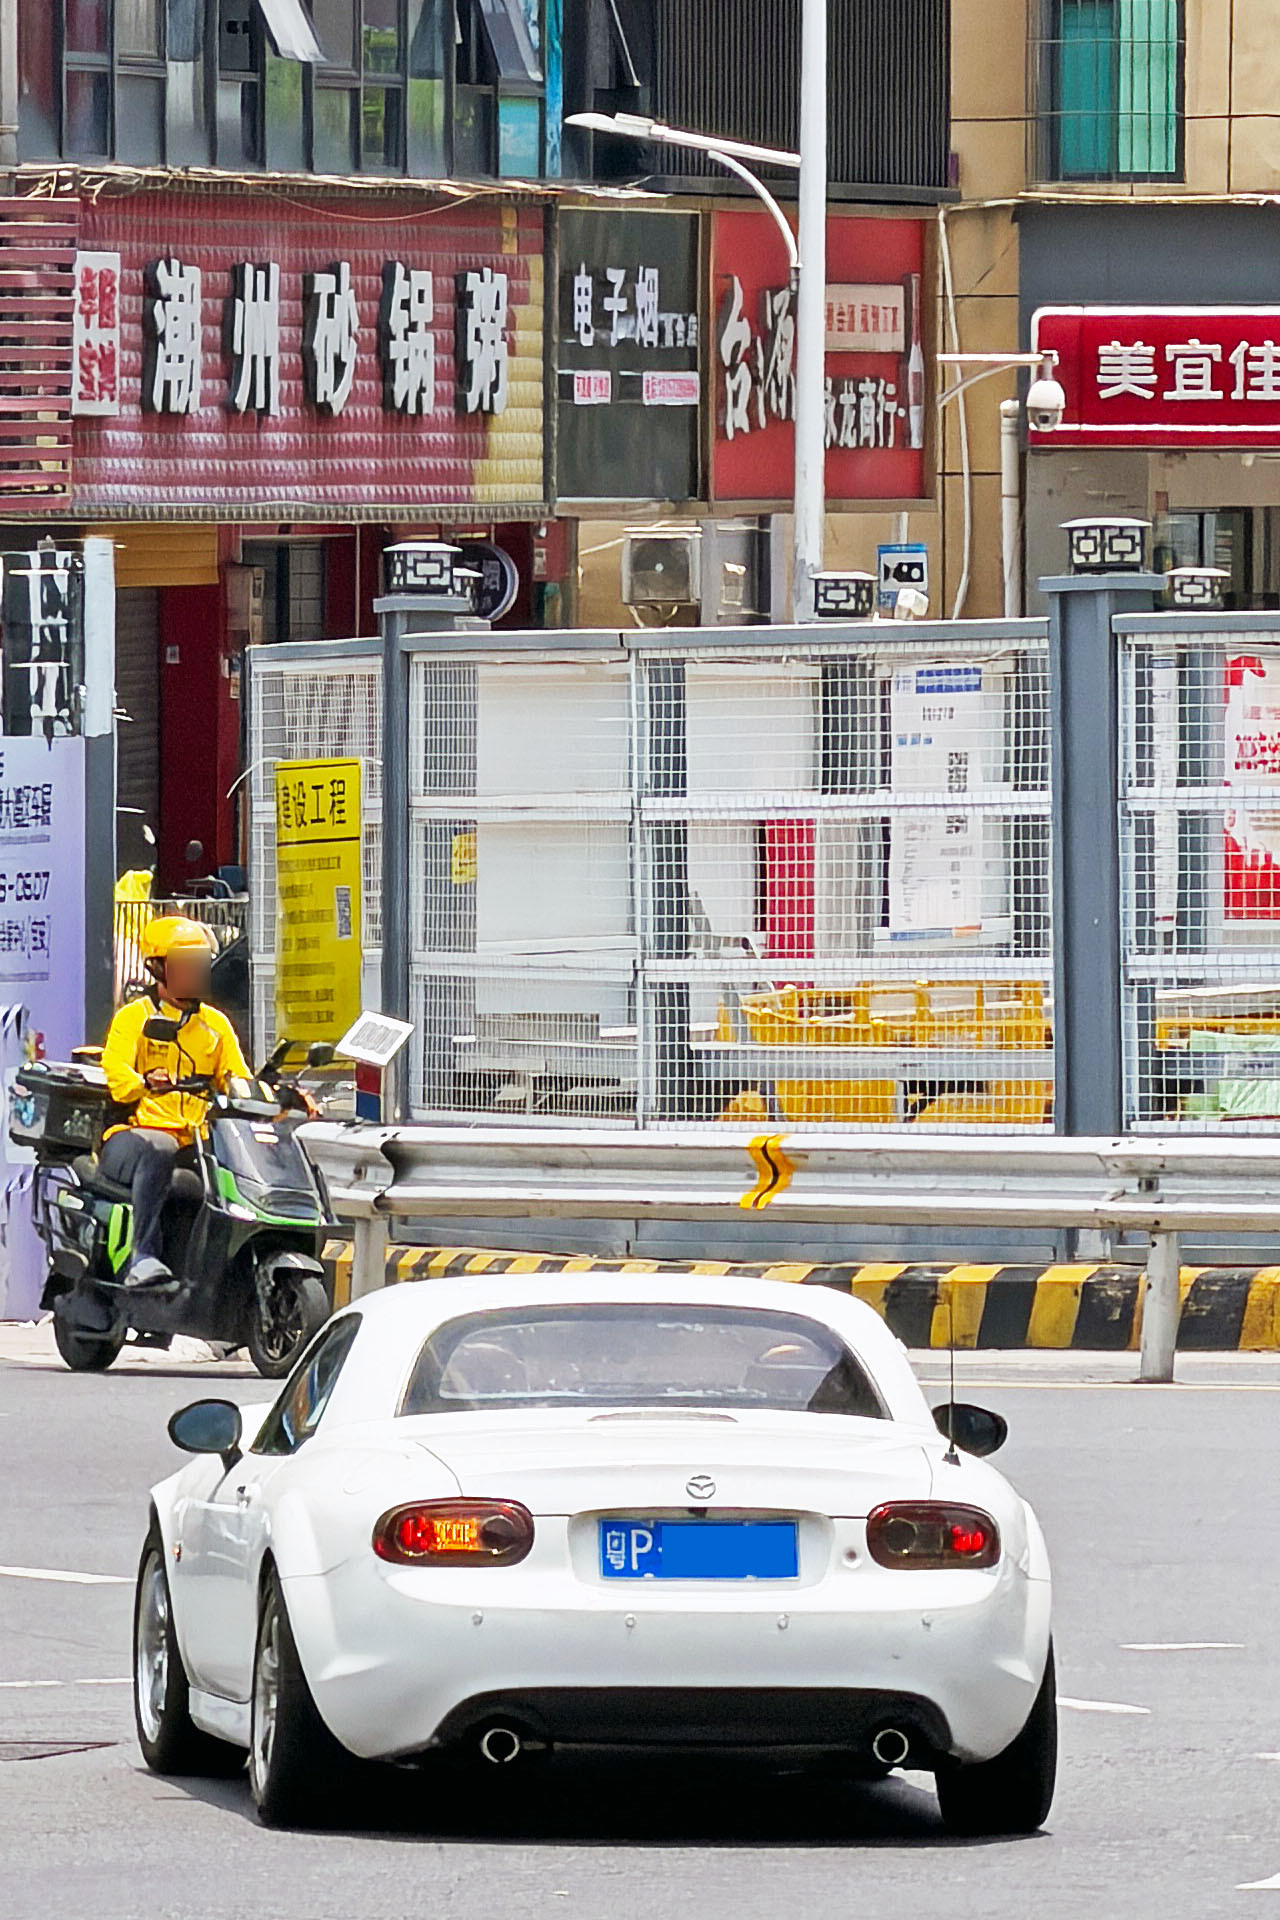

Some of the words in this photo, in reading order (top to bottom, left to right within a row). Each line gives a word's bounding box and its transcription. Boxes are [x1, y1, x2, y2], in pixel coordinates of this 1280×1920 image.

[152, 258, 508, 416] 潮州砂锅粥
[1096, 338, 1280, 401] 美宜佳
